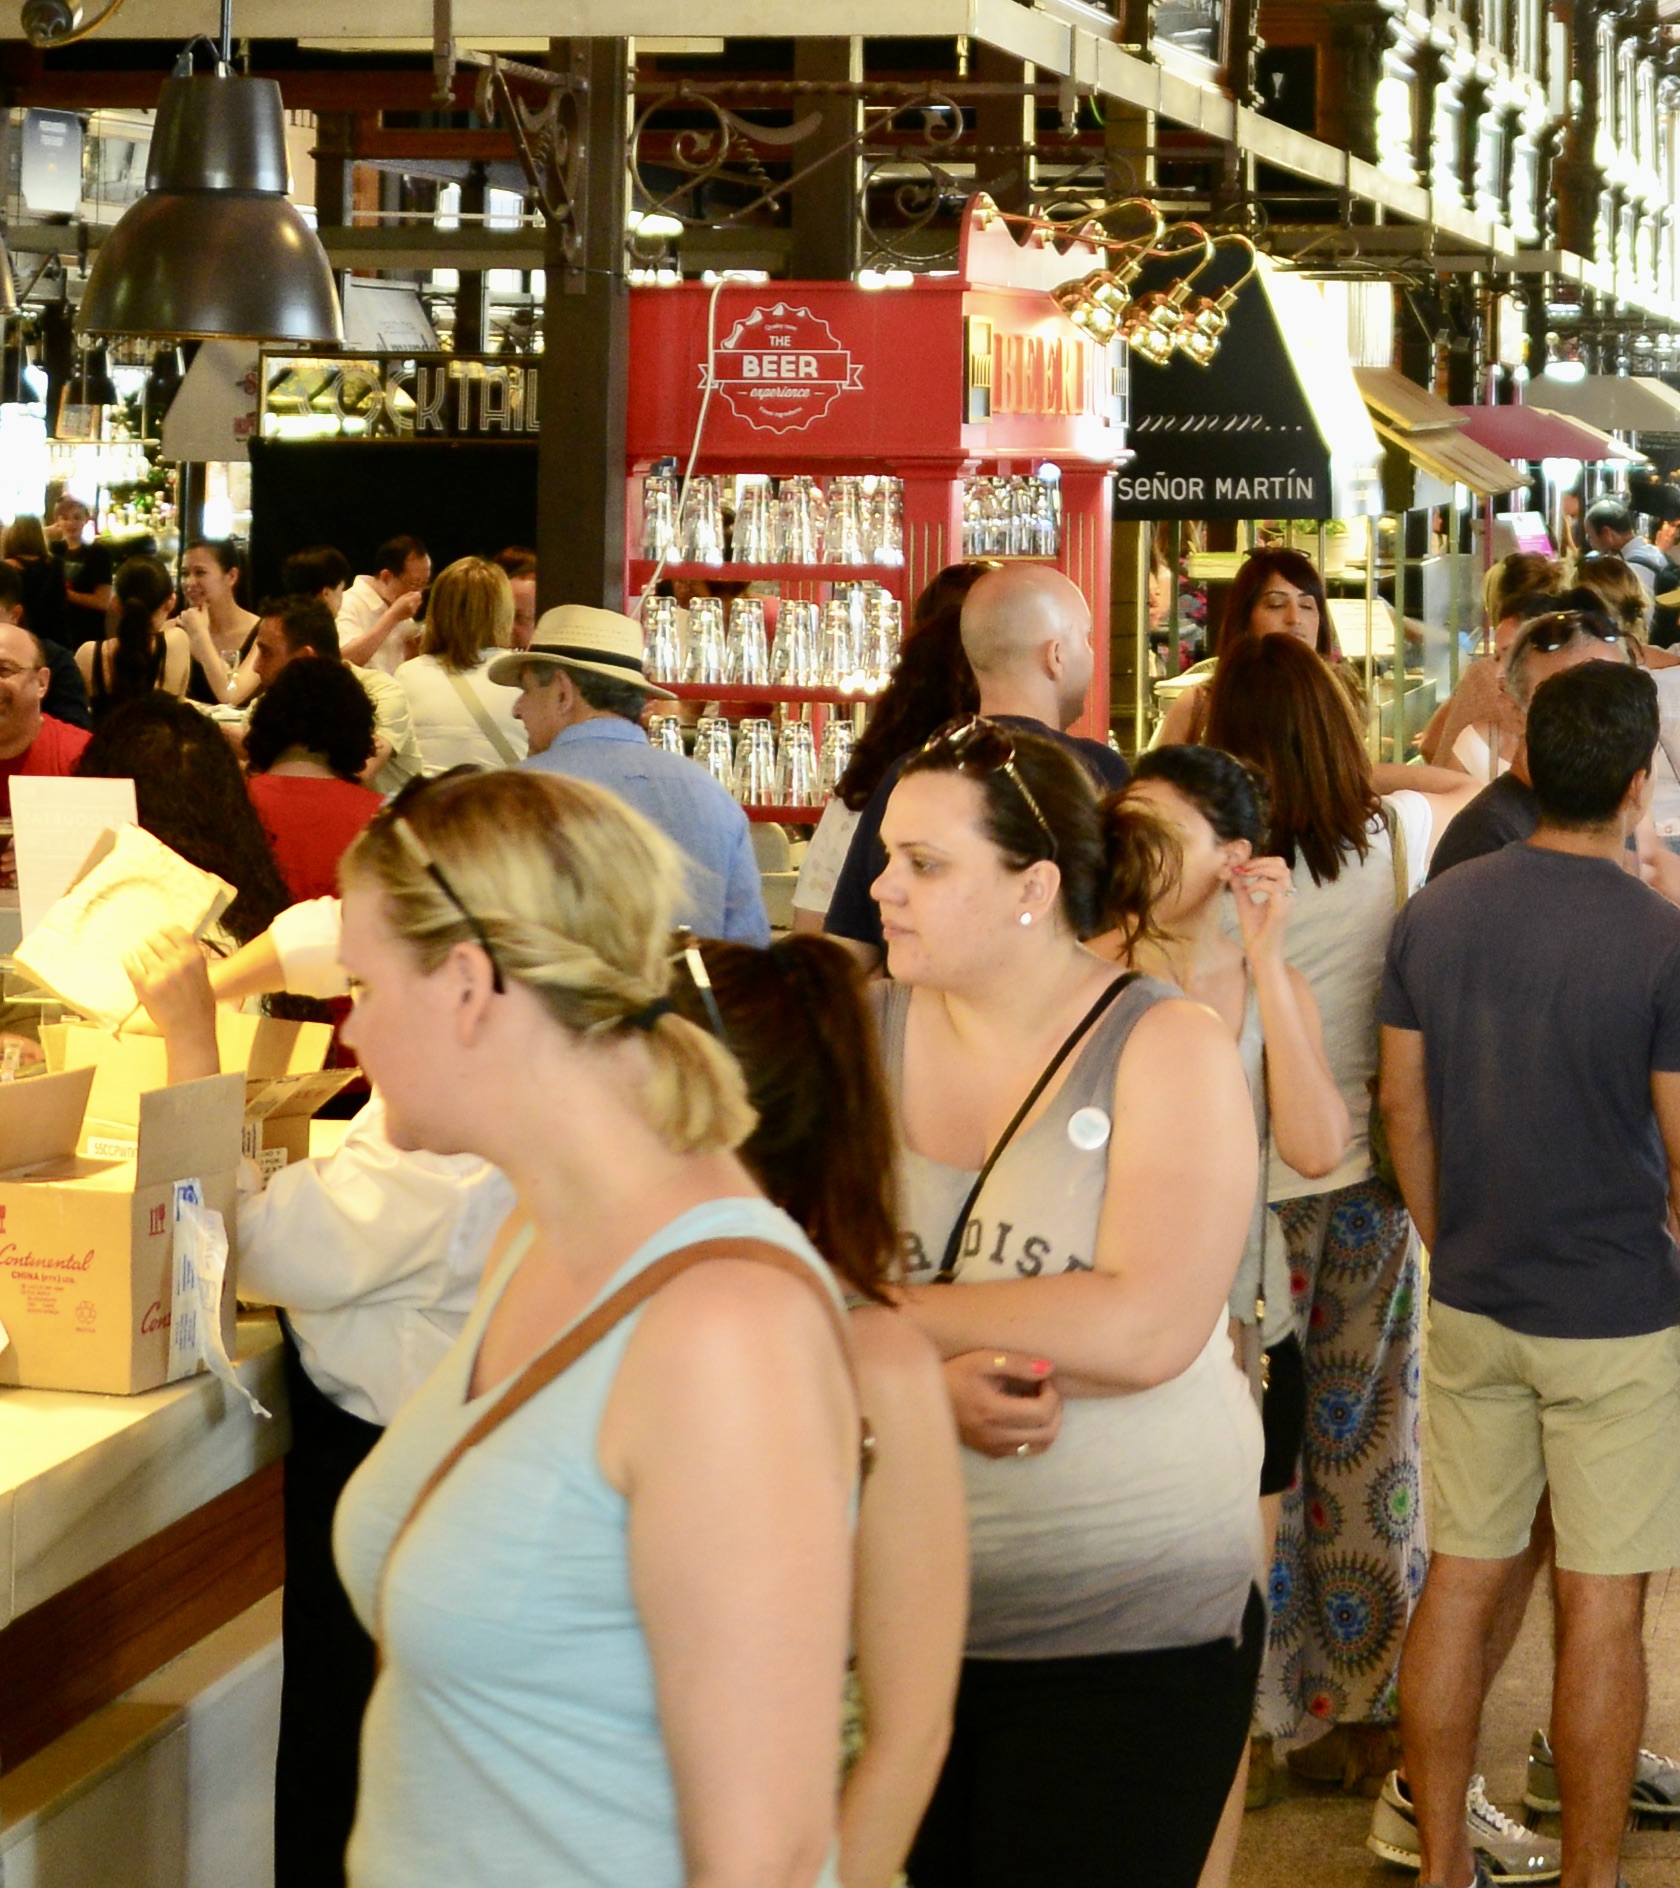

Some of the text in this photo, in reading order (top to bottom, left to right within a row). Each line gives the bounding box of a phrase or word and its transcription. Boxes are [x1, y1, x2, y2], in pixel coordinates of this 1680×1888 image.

[769, 335, 792, 347] THE
[743, 355, 818, 378] BEER
[750, 385, 811, 401] experience
[1215, 468, 1313, 500] MARTÍN
